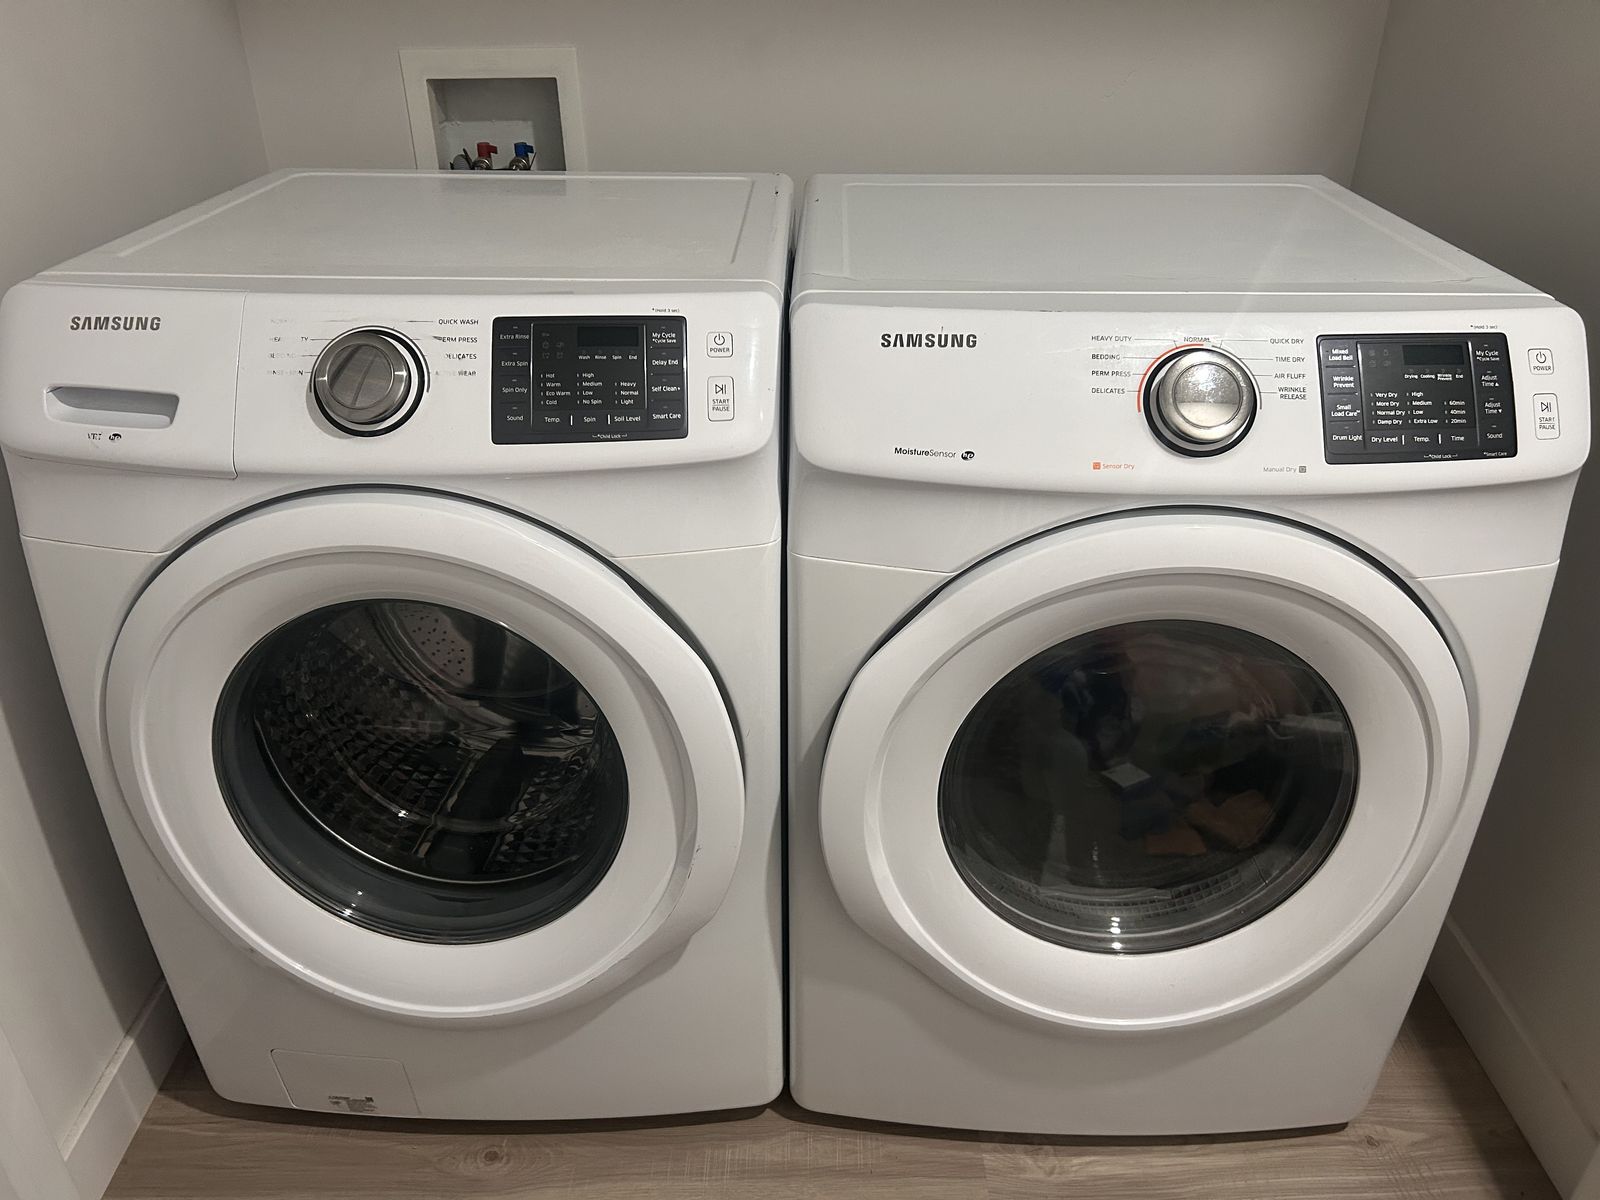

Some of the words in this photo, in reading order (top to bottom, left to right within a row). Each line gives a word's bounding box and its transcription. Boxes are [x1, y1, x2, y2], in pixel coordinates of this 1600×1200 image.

[70, 316, 161, 330] SAMSUNG
[880, 333, 977, 348] SAMSUNG
[894, 447, 956, 458] MoistureSensor
